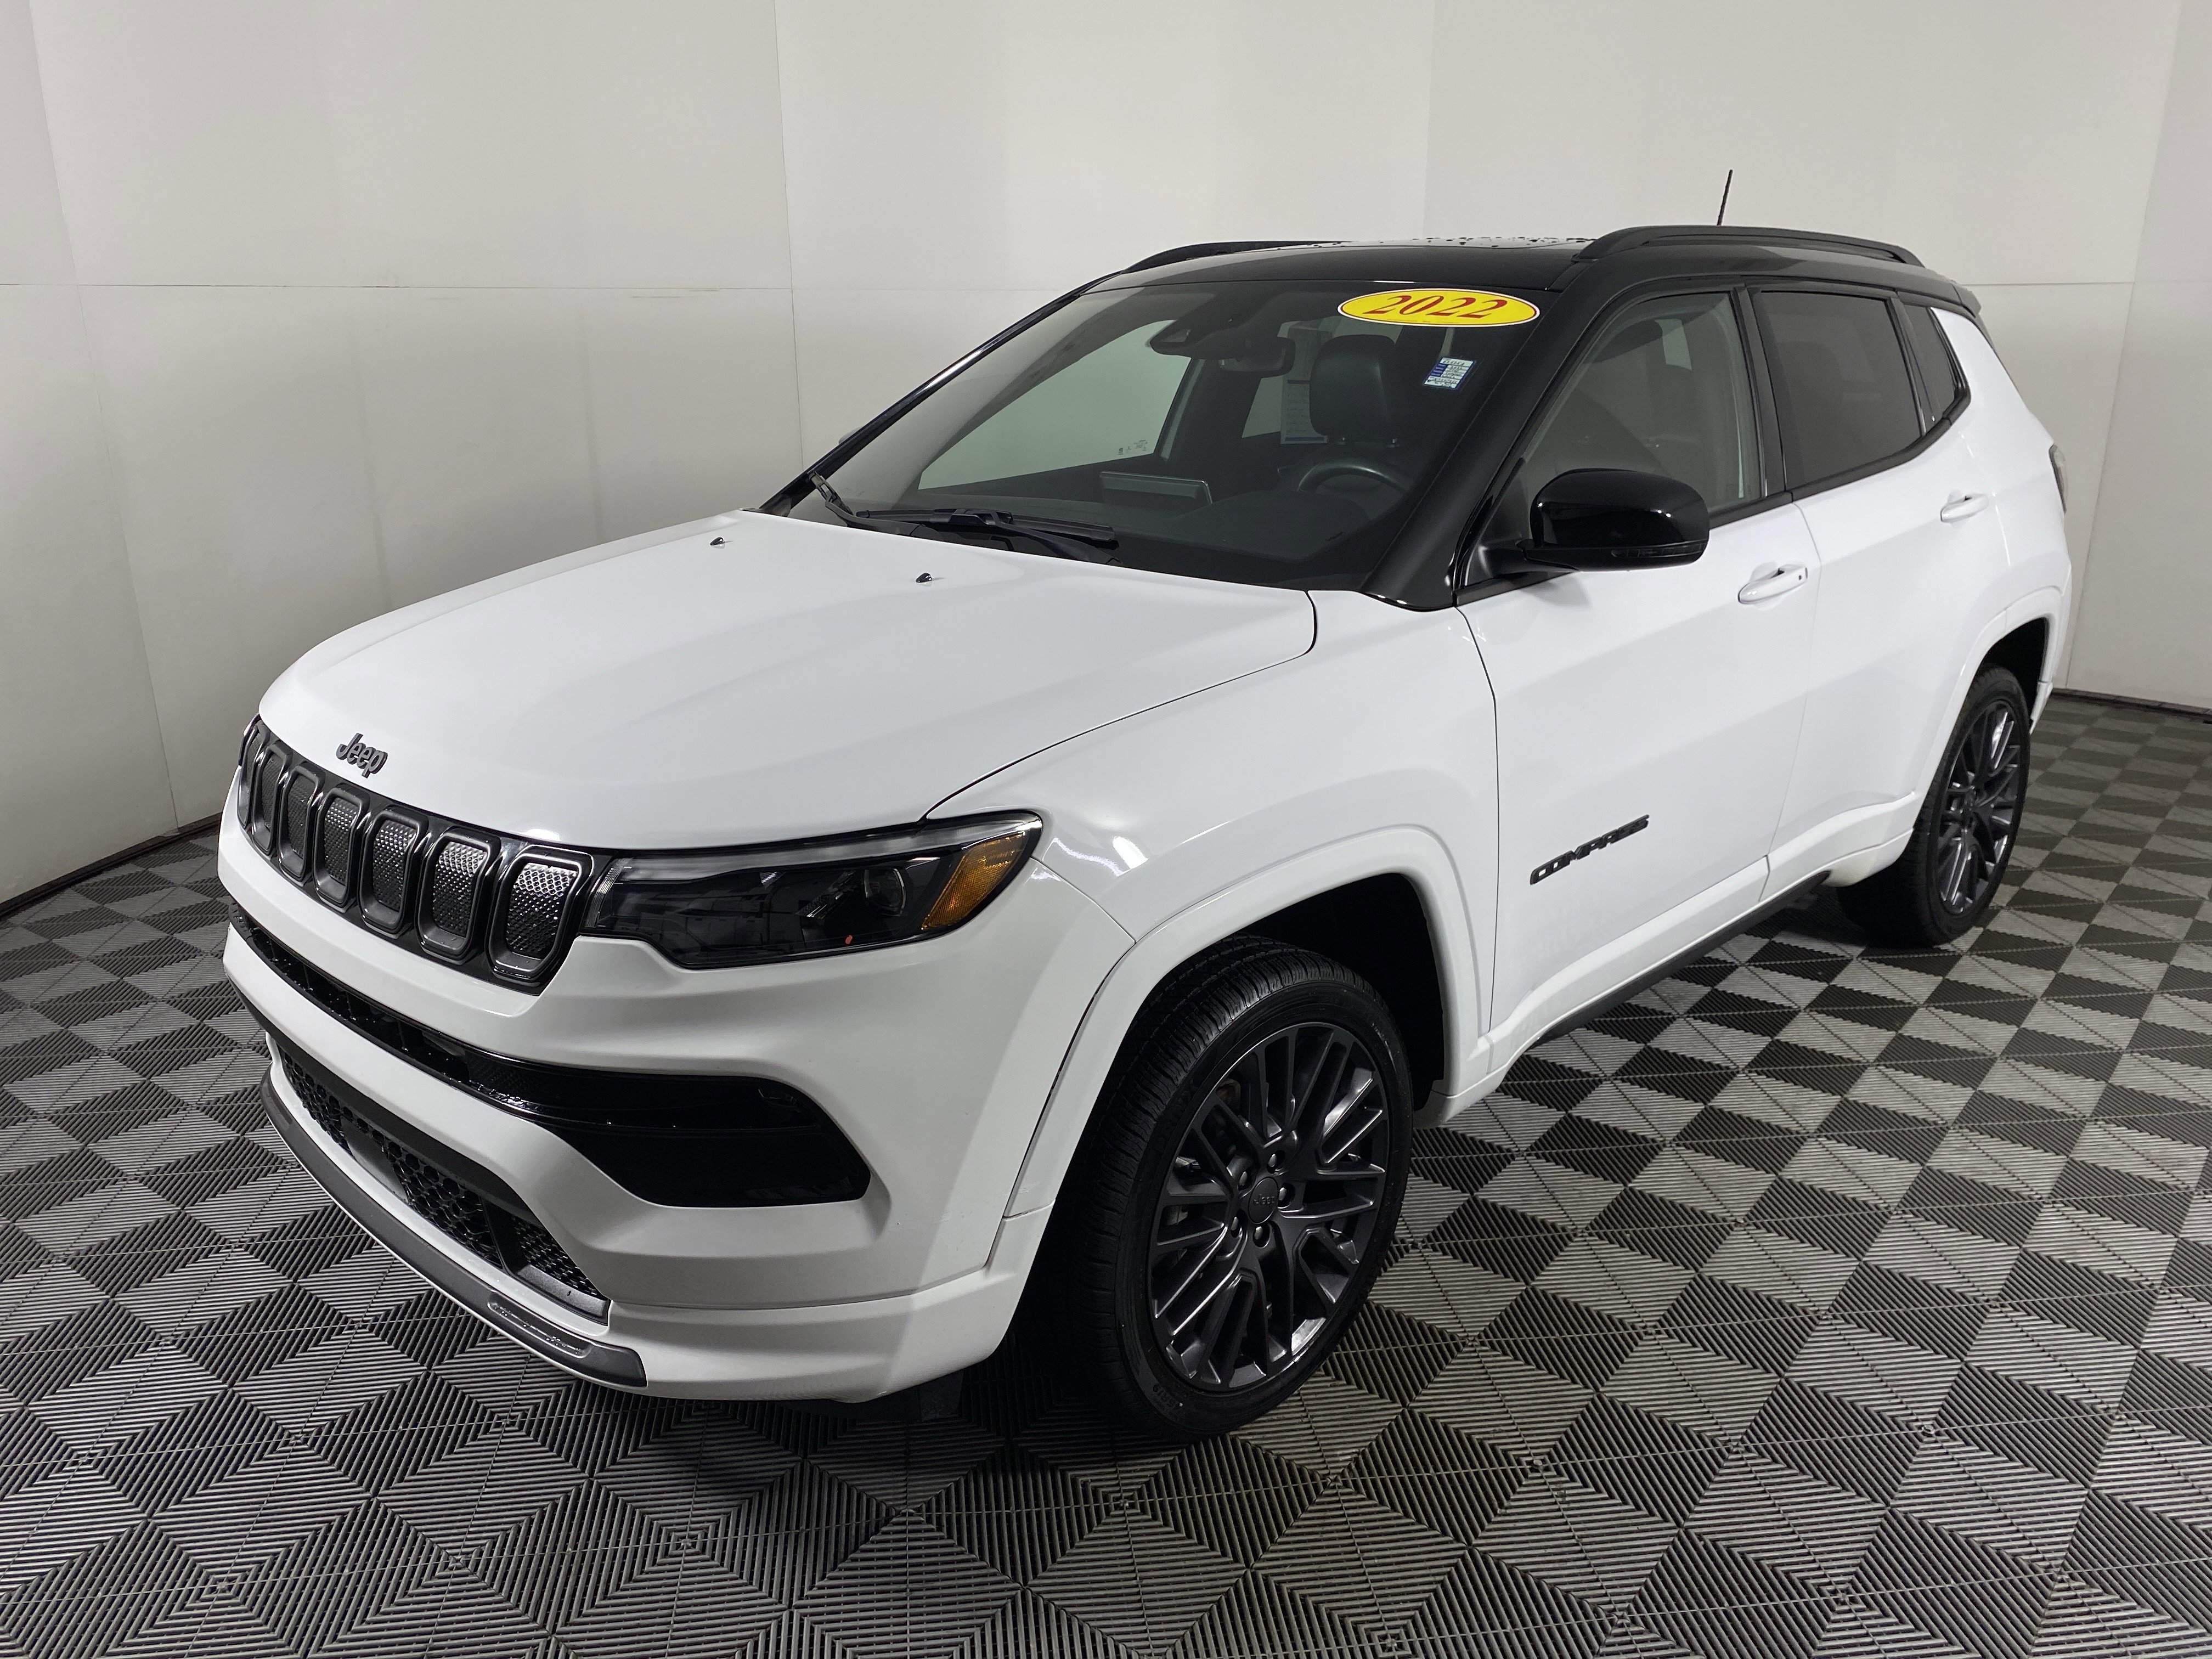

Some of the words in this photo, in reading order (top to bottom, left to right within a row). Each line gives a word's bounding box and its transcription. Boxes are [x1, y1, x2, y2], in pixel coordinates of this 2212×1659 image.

[1363, 295, 1508, 319] 2022
[336, 732, 388, 778] Jeep
[1530, 814, 1650, 885] COMPASS
[1252, 1193, 1276, 1205] Jeep
